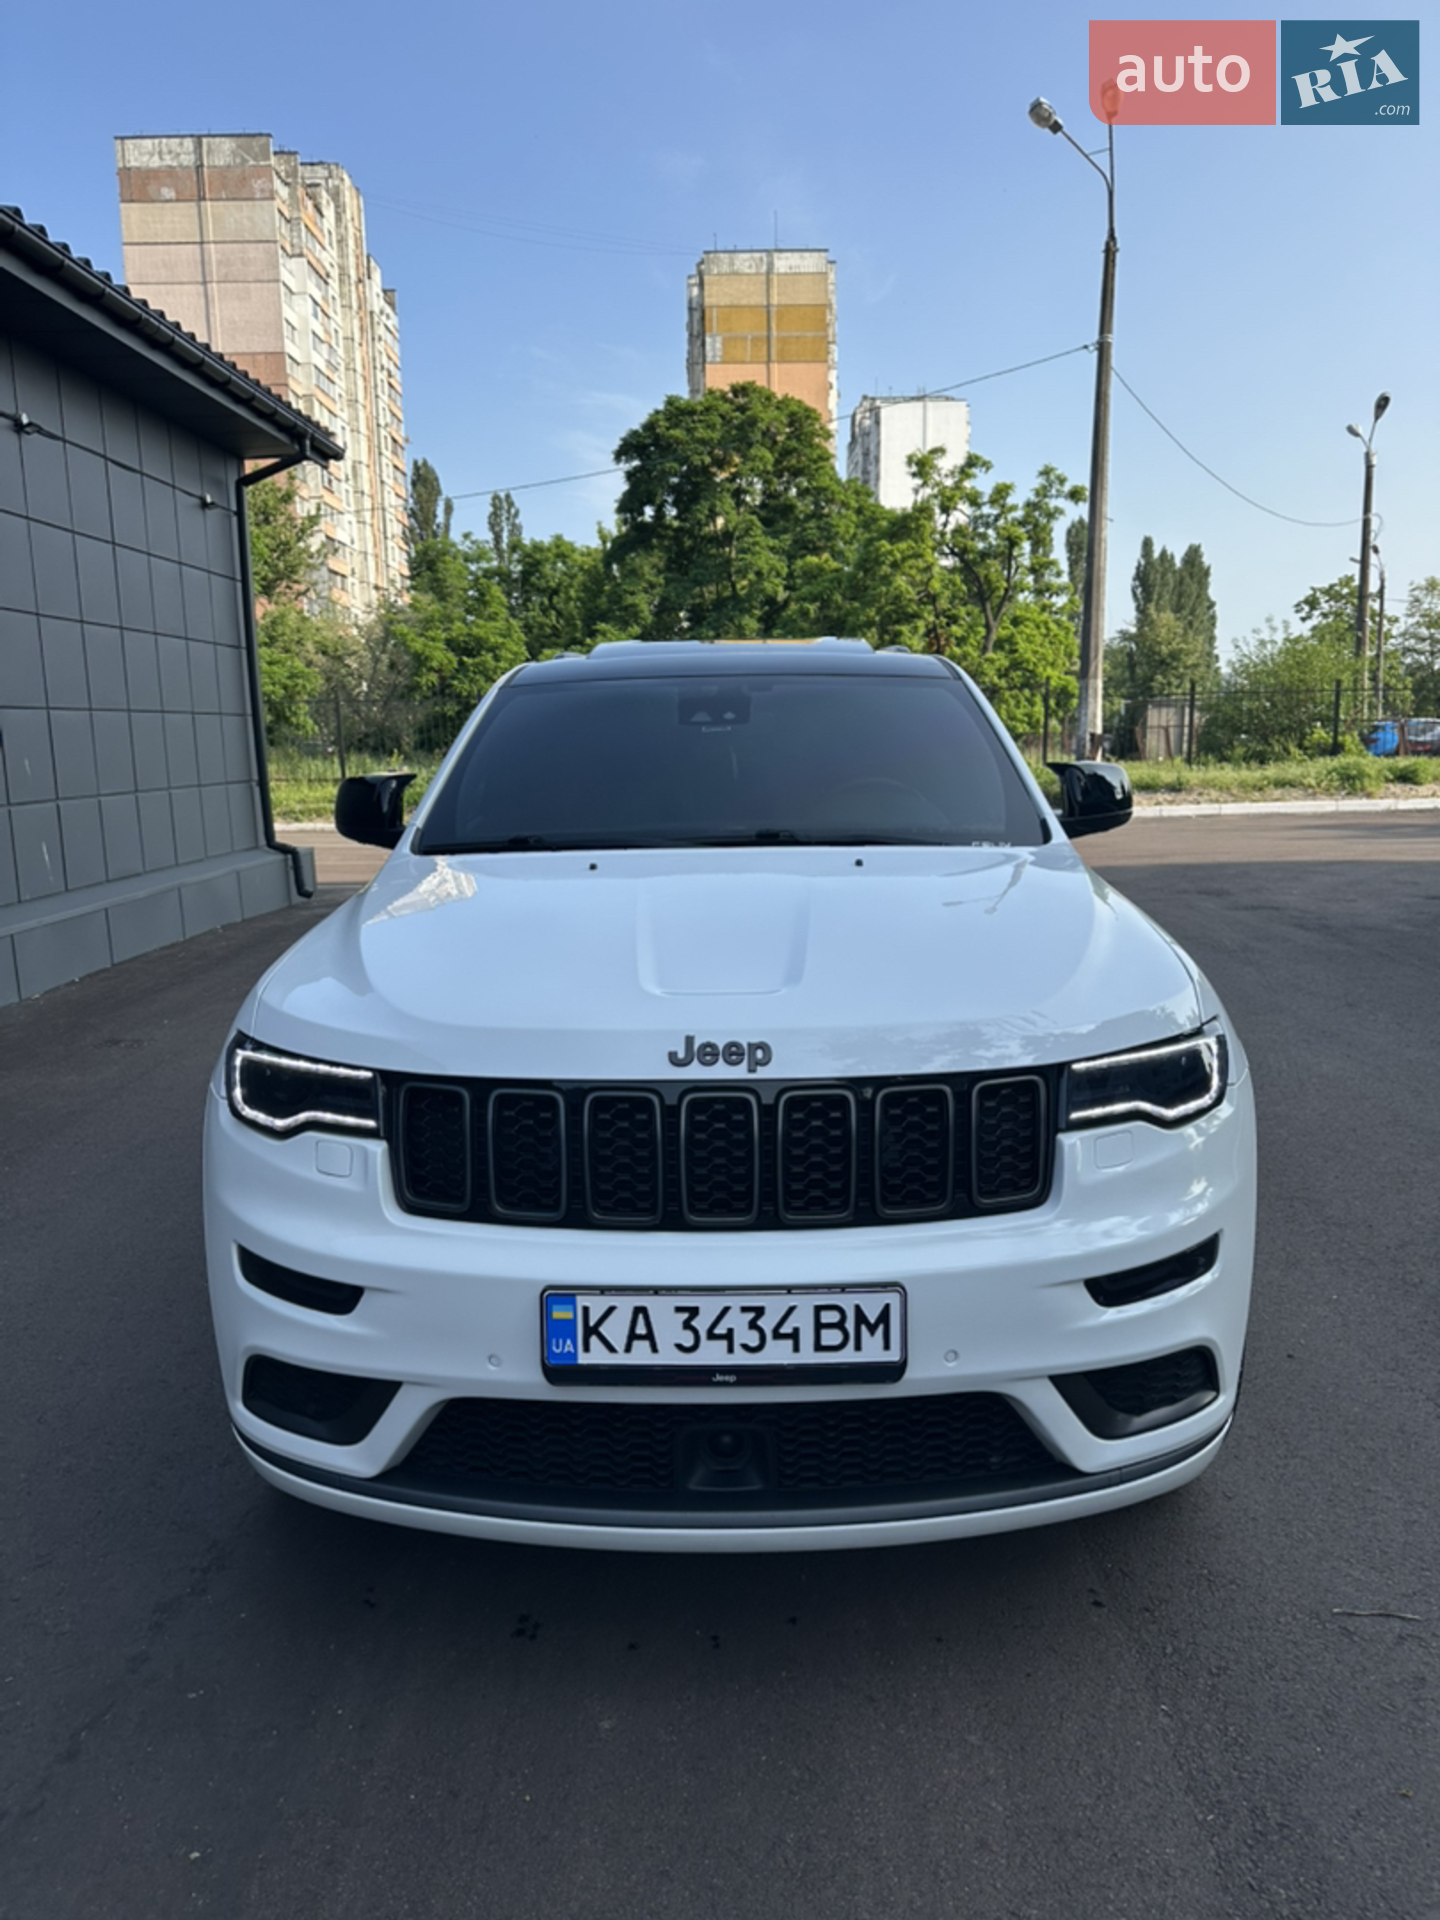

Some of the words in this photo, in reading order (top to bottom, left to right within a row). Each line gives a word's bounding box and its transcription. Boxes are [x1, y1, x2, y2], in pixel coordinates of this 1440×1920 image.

[667, 1034, 773, 1074] Jeep
[580, 1304, 659, 1354] KA
[673, 1304, 801, 1354] 3434
[812, 1302, 892, 1353] BM
[551, 1338, 575, 1354] UA
[711, 1372, 737, 1384] Jeep
